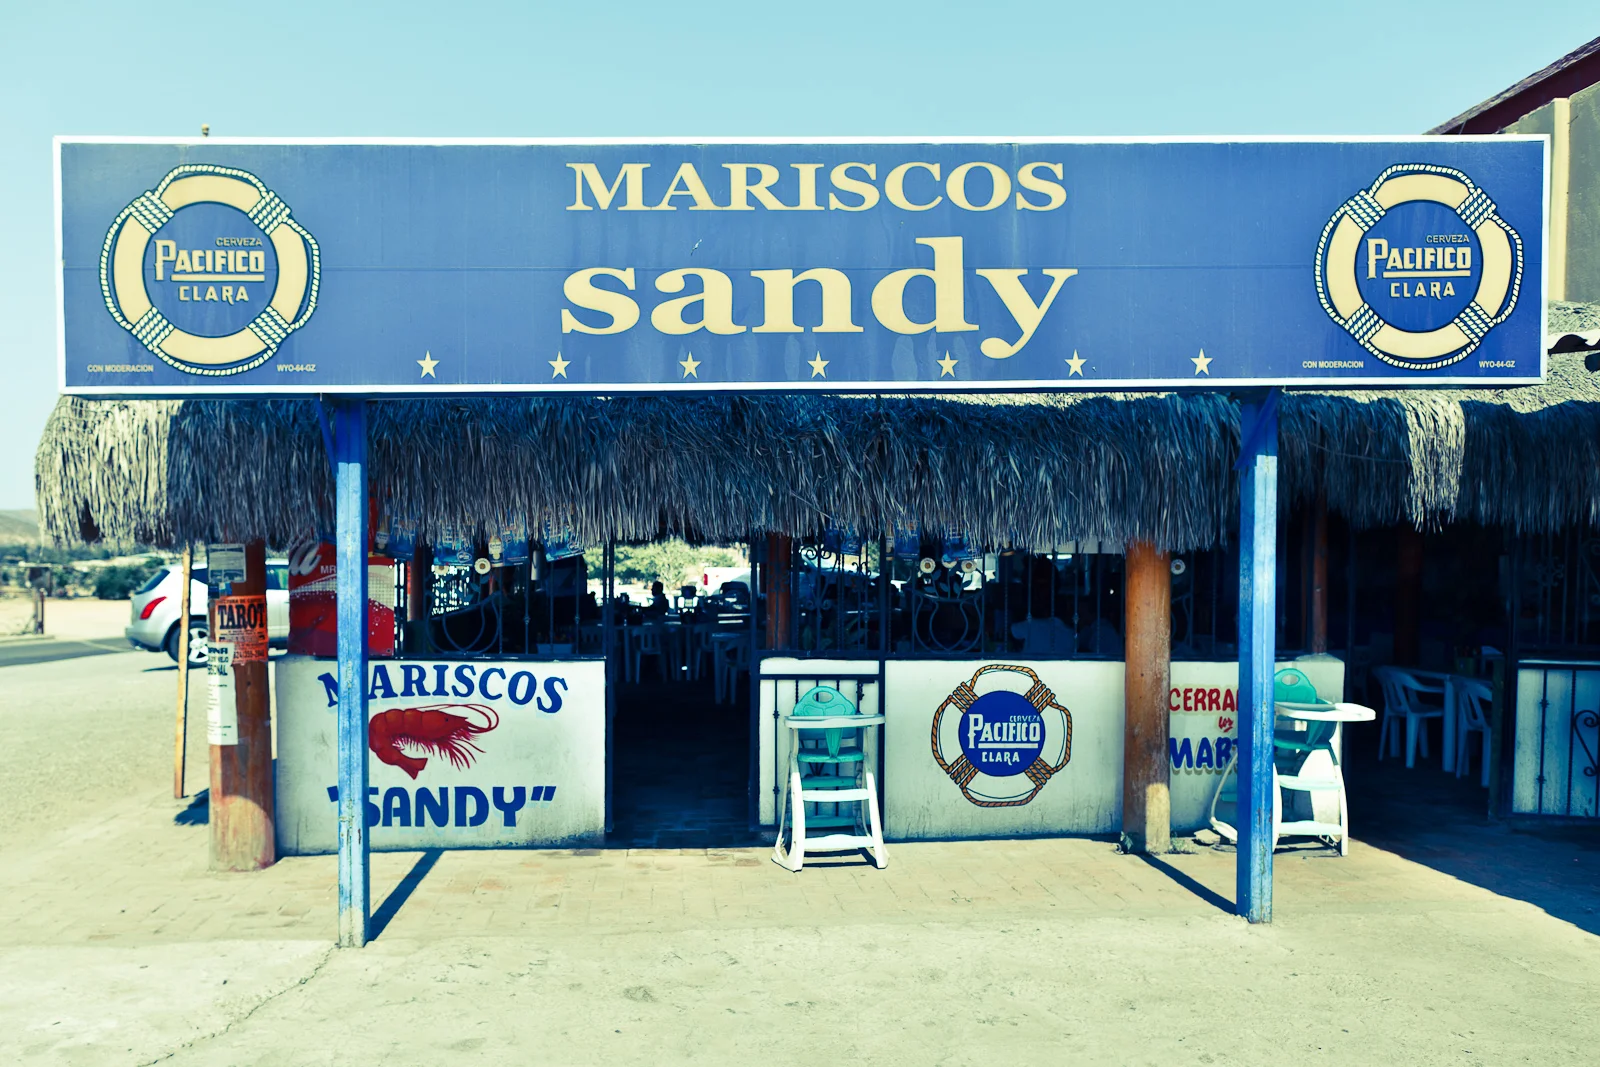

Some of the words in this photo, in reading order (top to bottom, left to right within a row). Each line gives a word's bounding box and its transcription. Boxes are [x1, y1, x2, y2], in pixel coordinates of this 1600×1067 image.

[565, 161, 1067, 212] MARISCOS
[215, 236, 263, 247] CERVEZA
[1426, 234, 1470, 244] CERVEZA
[153, 239, 265, 282] PACIFICO
[1366, 238, 1472, 279] PACIFICO
[178, 285, 249, 305] CLARA
[560, 236, 1078, 359] sandy
[1390, 281, 1456, 300] CLARA
[87, 364, 104, 373] CON
[105, 364, 154, 373] MODERACION
[1302, 360, 1318, 369] CON
[1319, 360, 1364, 369] MODERACION
[217, 603, 266, 630] TAROT
[1169, 688, 1239, 712] CERRA
[968, 714, 1041, 749] PACIFICO
[981, 751, 1021, 766] CLARA
[1169, 736, 1238, 769] MAR
